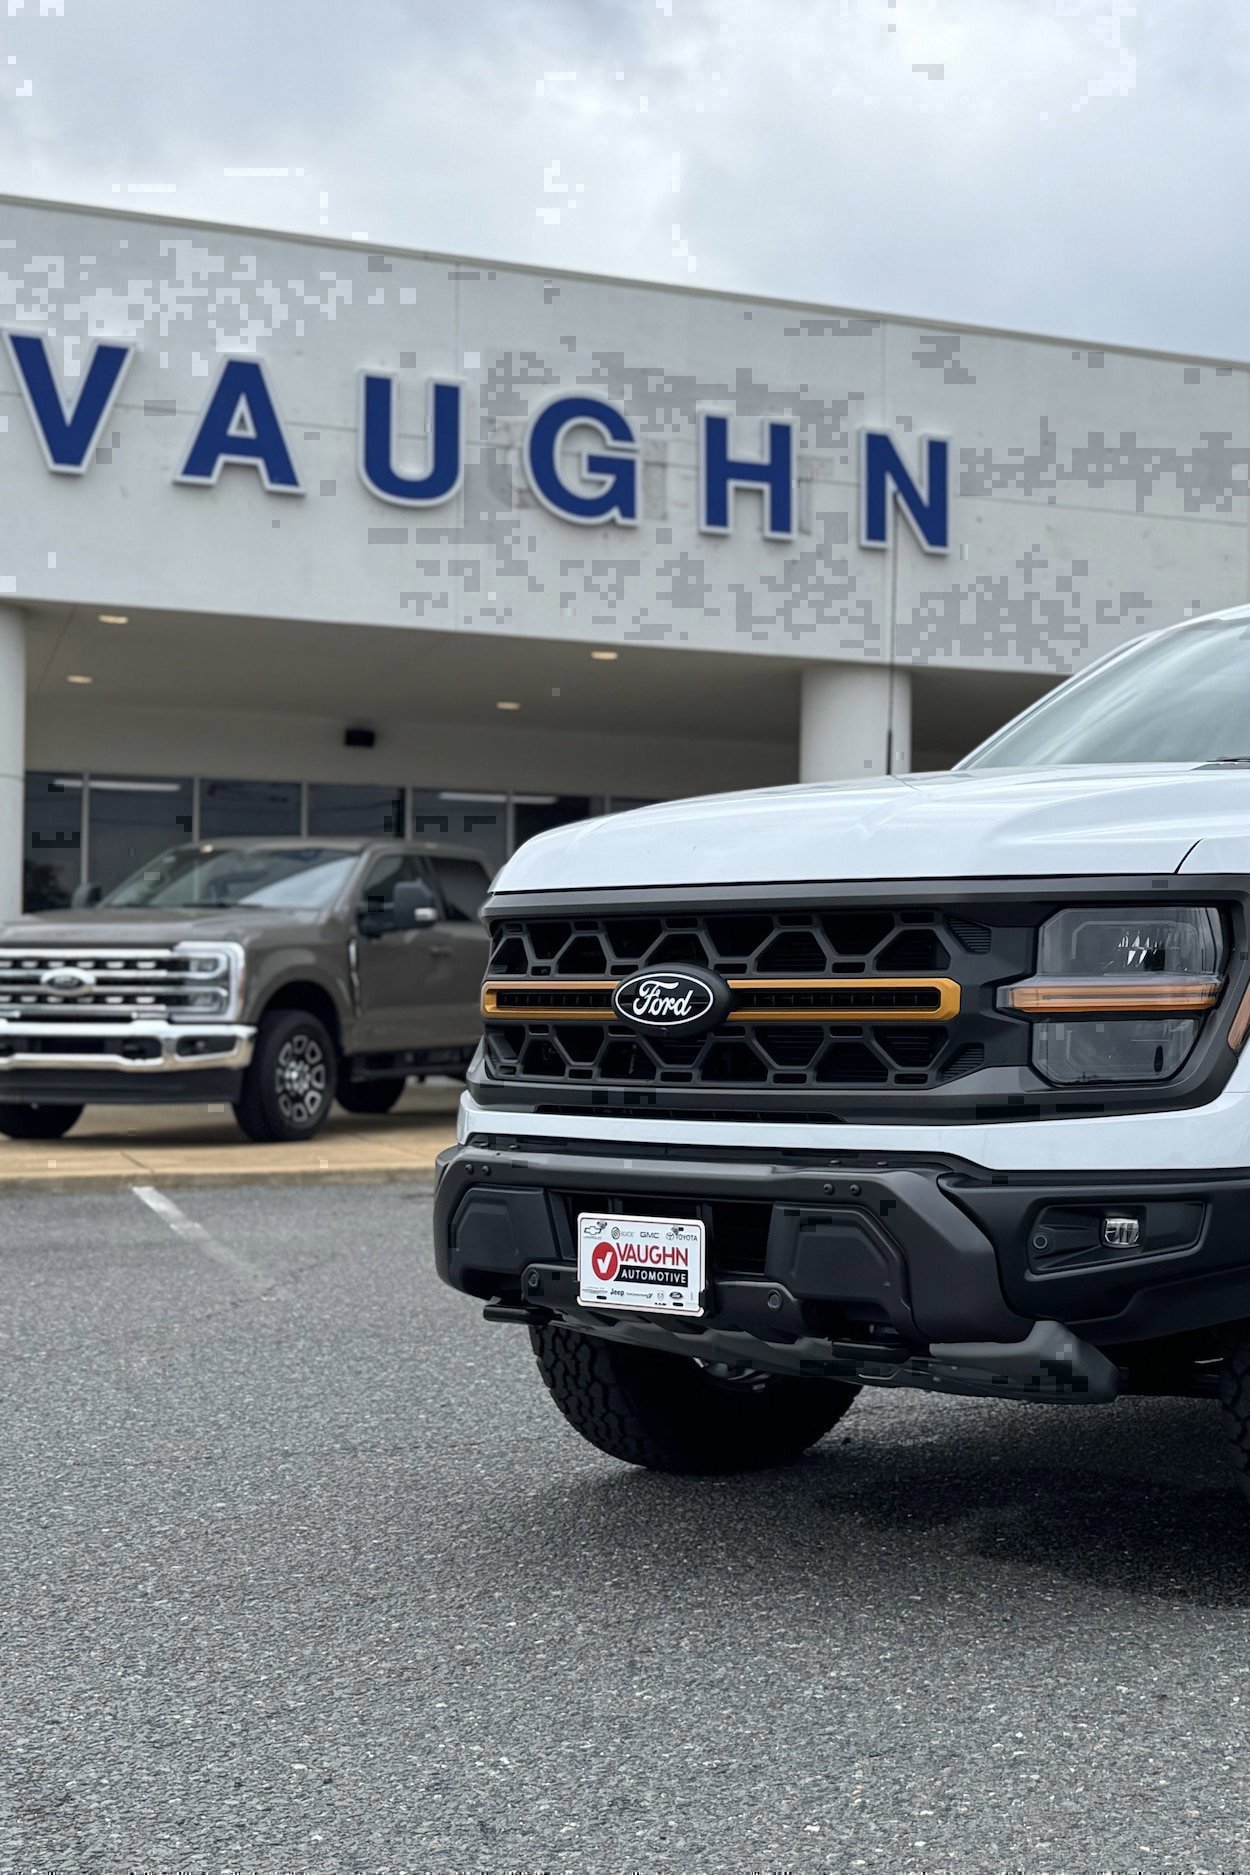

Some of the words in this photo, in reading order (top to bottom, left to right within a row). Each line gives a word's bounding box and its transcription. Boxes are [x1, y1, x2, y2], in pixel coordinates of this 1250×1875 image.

[3, 327, 953, 556] VAUGHN
[633, 980, 694, 1016] Ford
[640, 1231, 660, 1239] GMC
[675, 1233, 698, 1241] TOYOTA
[616, 1242, 688, 1266] VAUGHN
[621, 1269, 686, 1284] AUTOMOTIVE
[610, 1288, 624, 1297] Jeep
